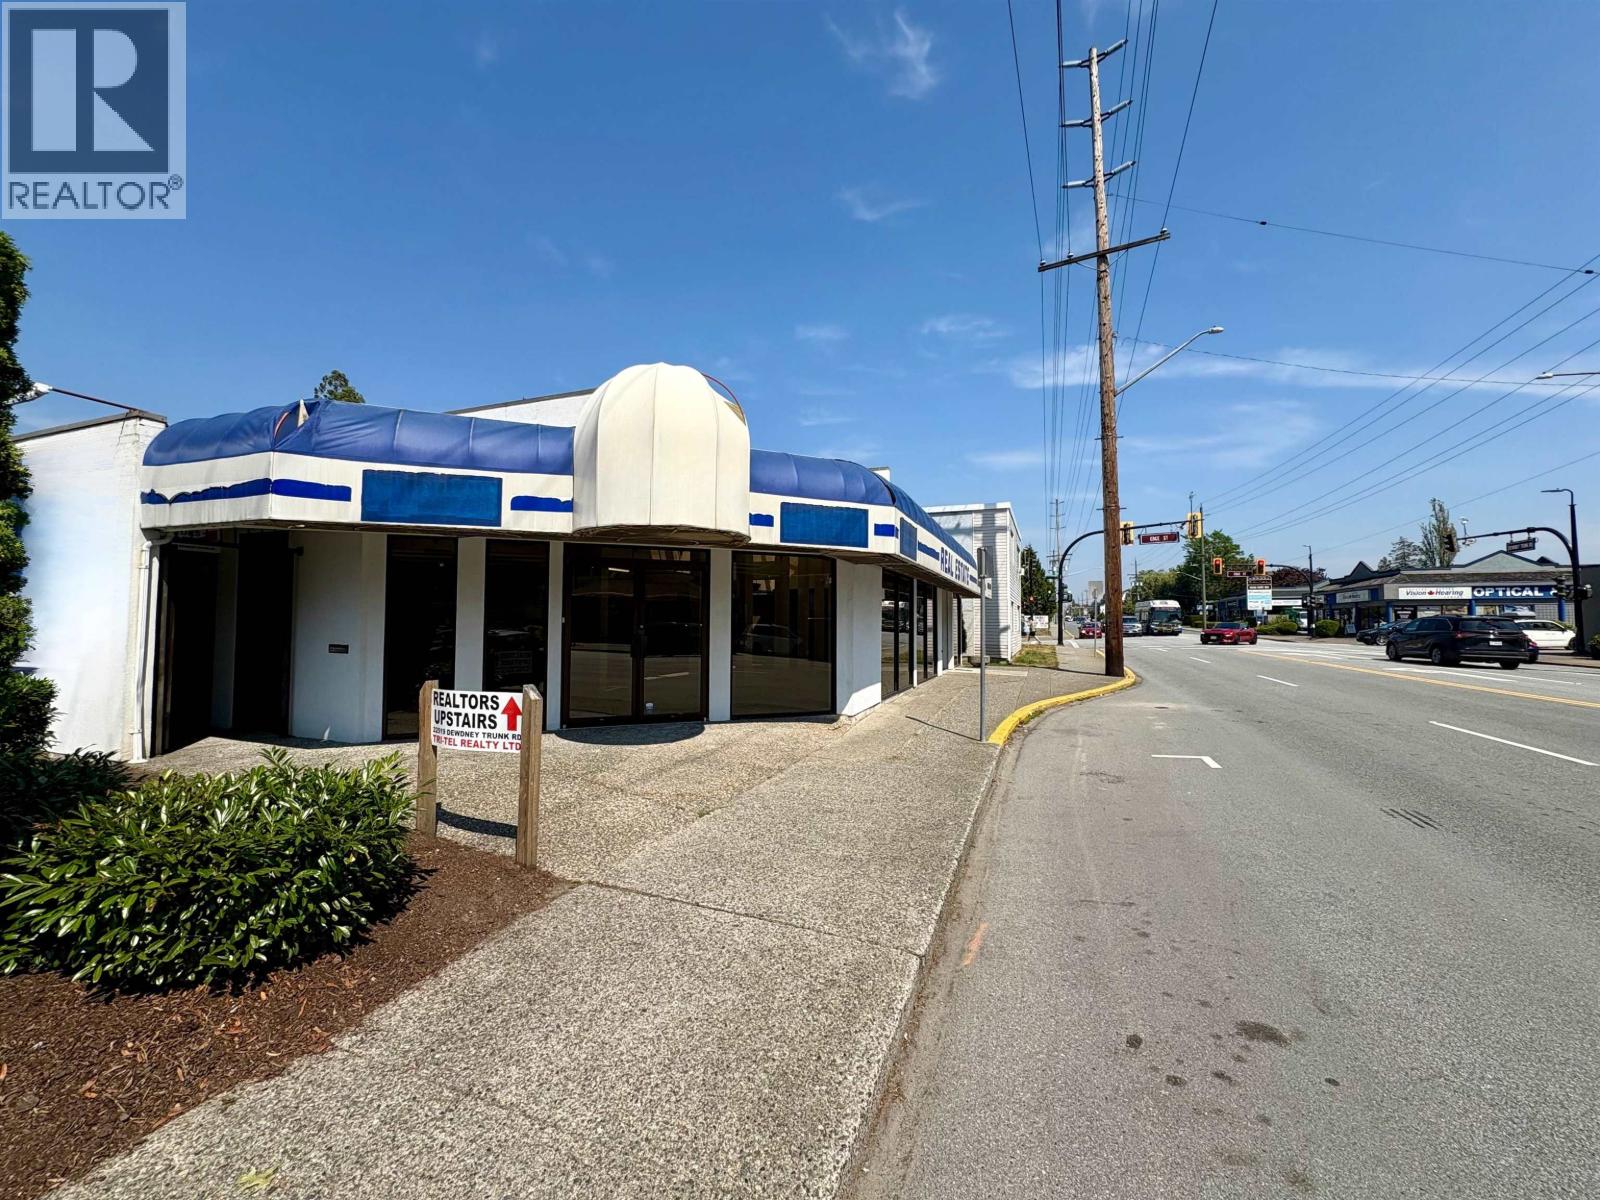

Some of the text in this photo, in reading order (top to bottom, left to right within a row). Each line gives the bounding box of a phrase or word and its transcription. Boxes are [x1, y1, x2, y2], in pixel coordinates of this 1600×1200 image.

[940, 546, 954, 577] REAL
[1435, 589, 1464, 597] Hearing
[1473, 587, 1544, 597] OPTICAL
[433, 691, 500, 711] REALTORS
[434, 709, 498, 730] UPSTAIRS
[432, 734, 522, 751] TRI-TEL REALTY LTD
[446, 729, 479, 739] DEWDNEY
[482, 732, 510, 740] TRUNK
[511, 733, 522, 741] RD
